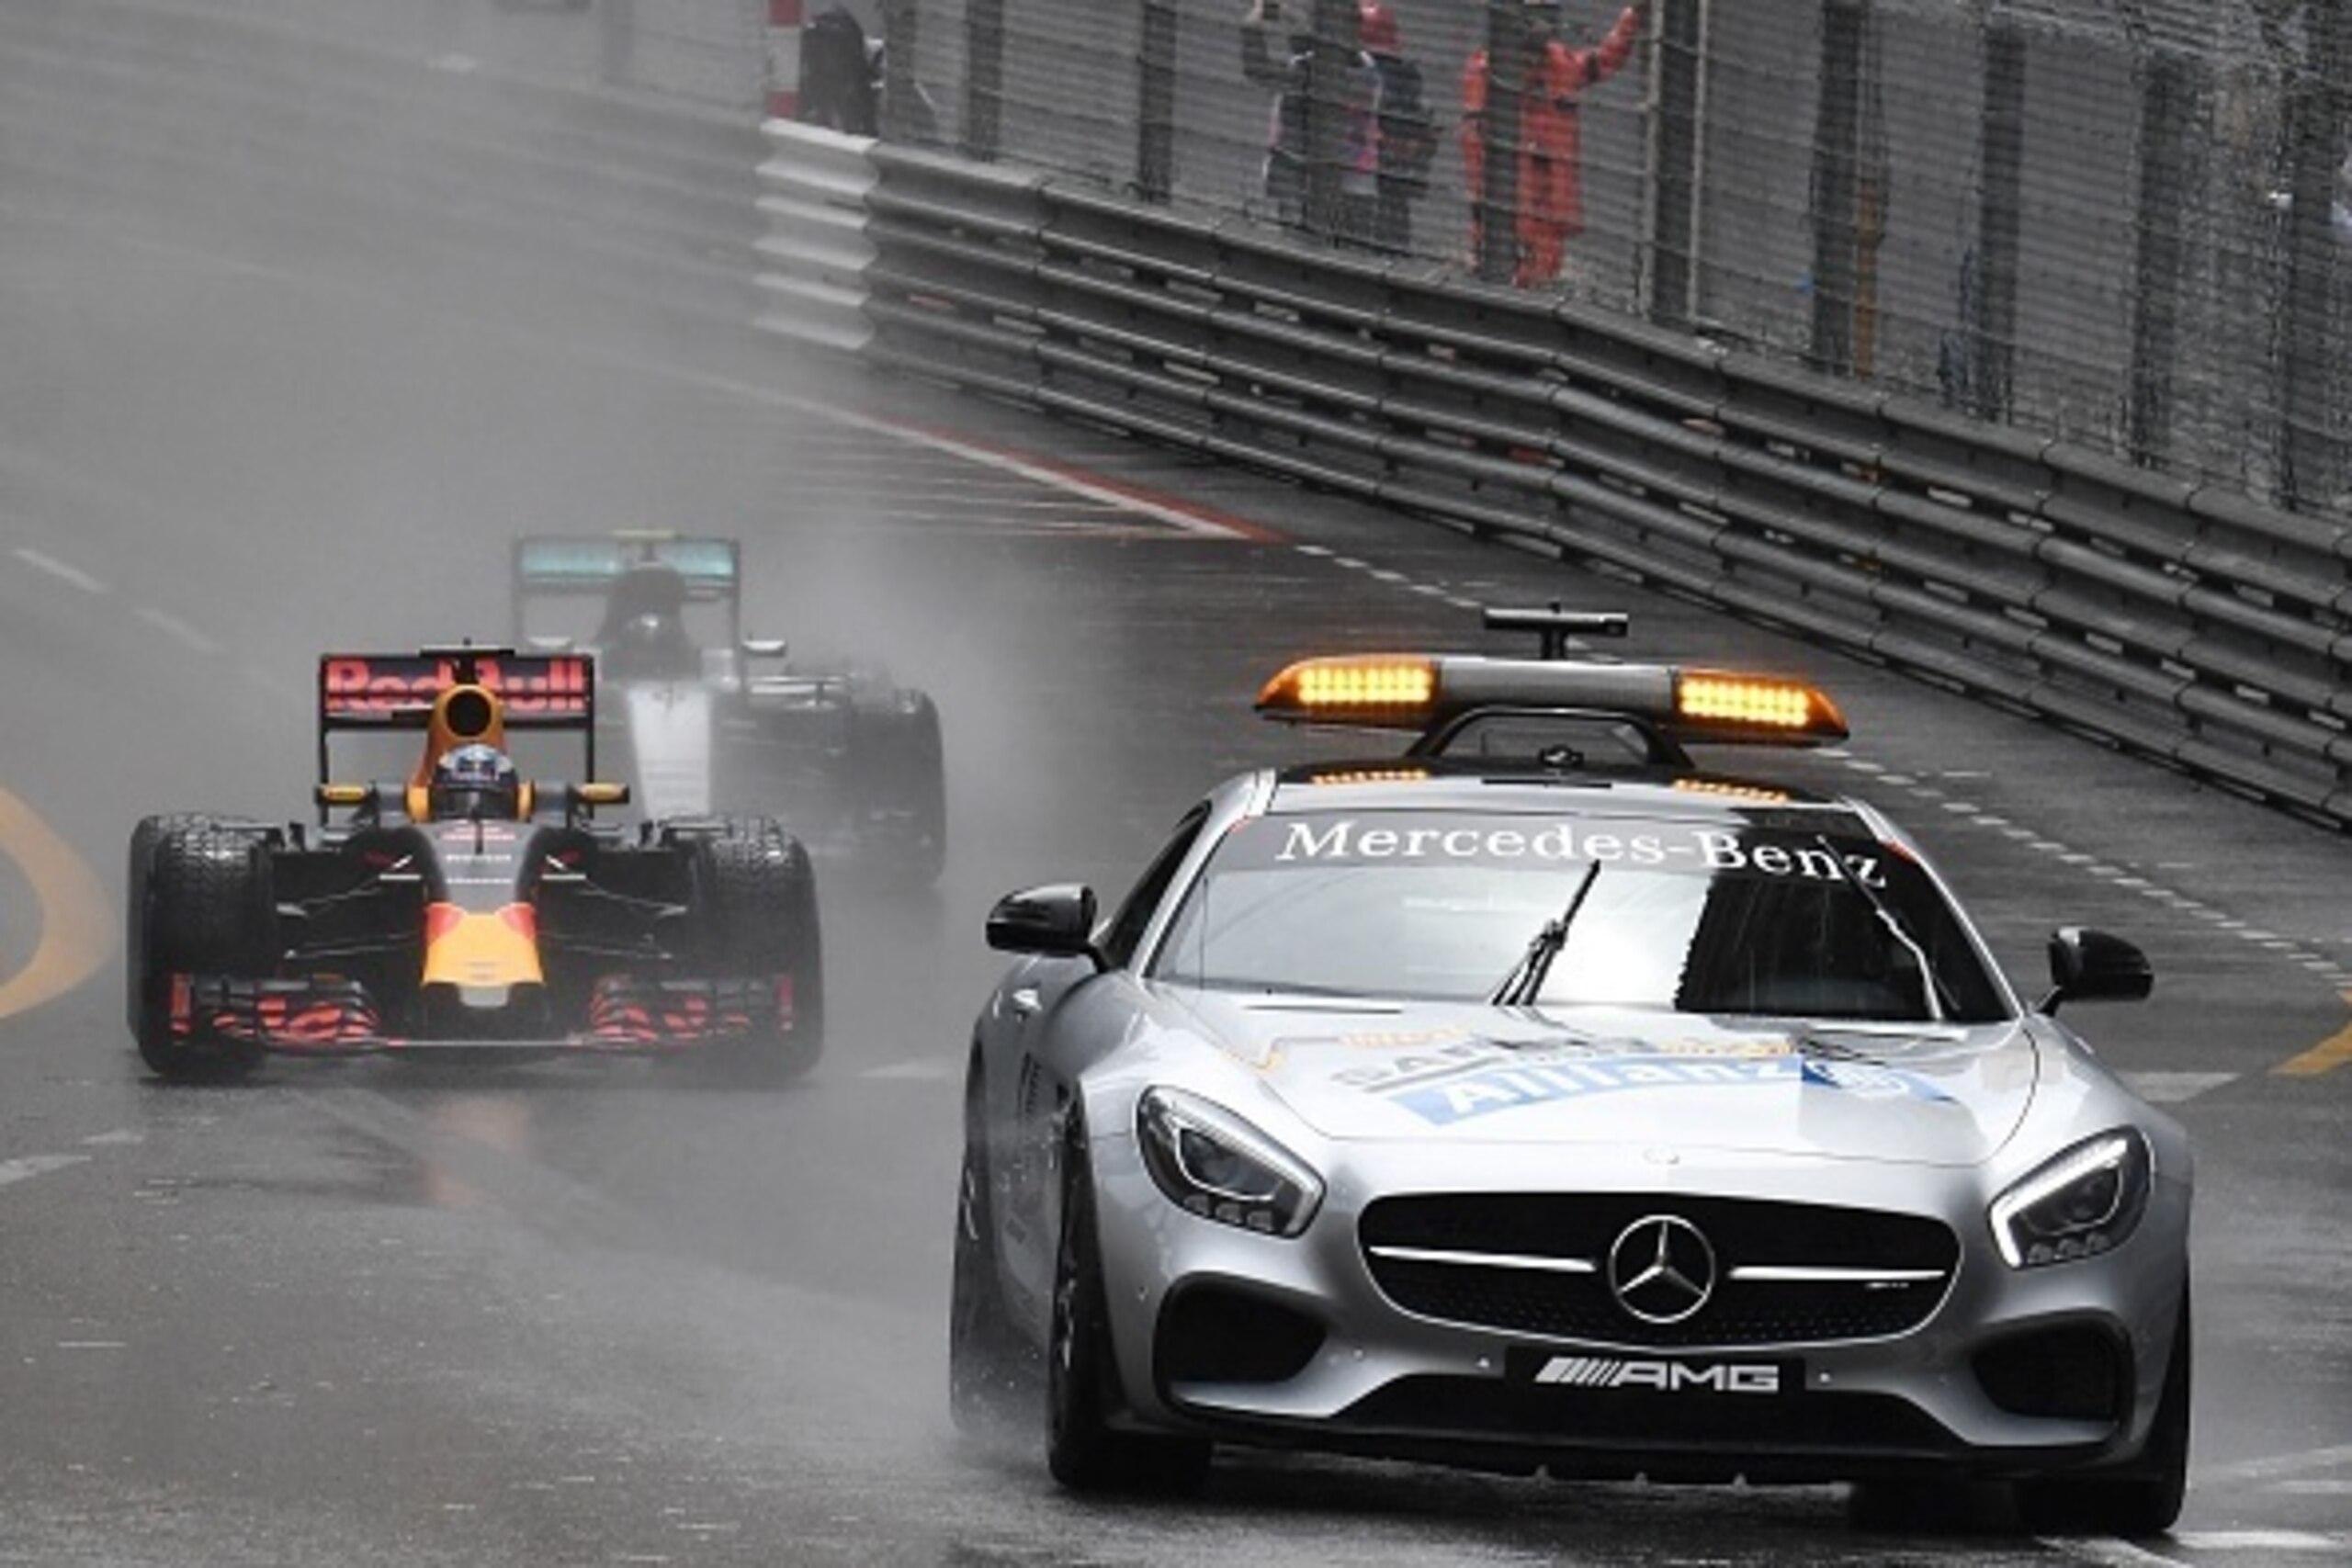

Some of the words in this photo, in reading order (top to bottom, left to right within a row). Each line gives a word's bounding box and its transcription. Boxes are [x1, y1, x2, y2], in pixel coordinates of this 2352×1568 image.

[1274, 822, 1884, 887] Mercedes-Benz
[1444, 1061, 1802, 1113] Allianz
[1607, 1359, 1779, 1392] AMG
